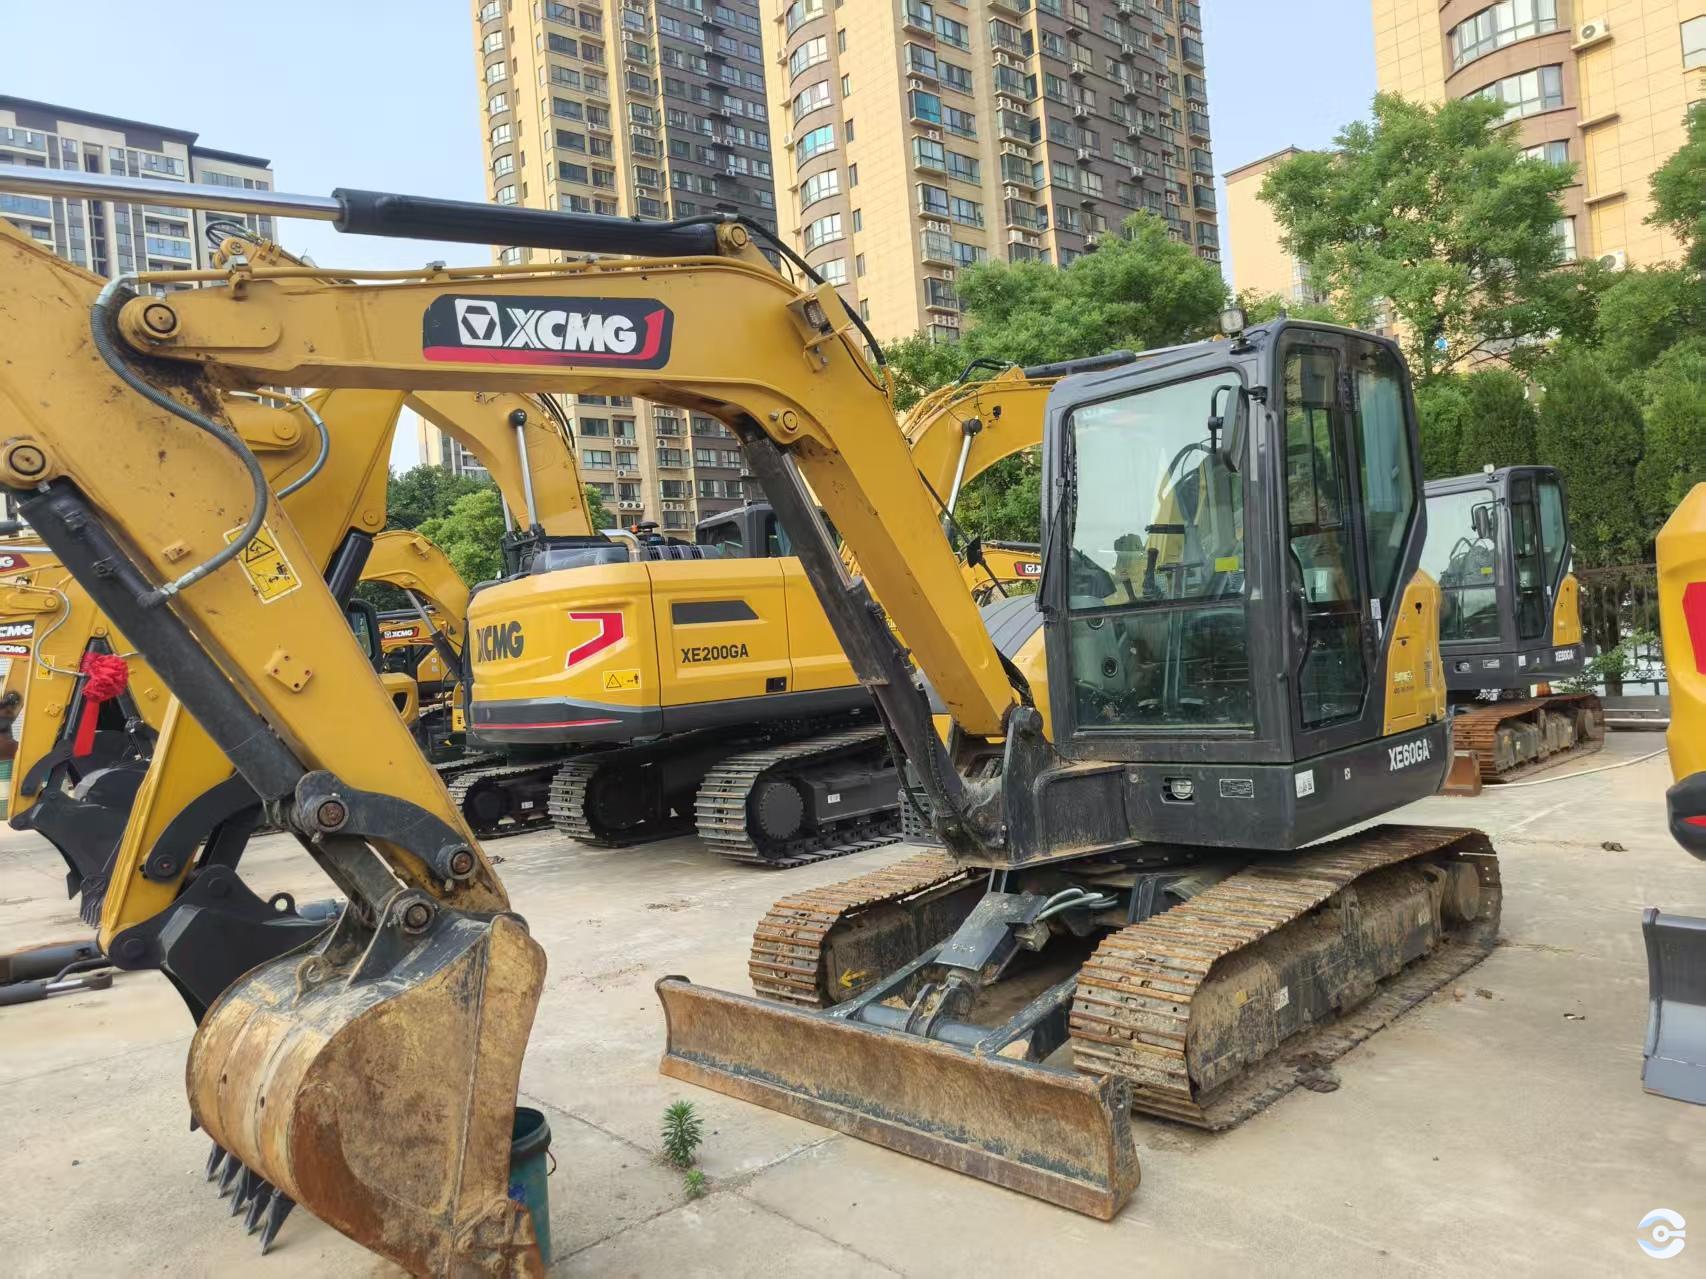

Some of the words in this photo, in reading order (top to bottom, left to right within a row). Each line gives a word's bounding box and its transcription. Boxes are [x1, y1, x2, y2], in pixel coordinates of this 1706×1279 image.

[502, 307, 637, 354] XCMG
[0, 624, 33, 637] CMG
[392, 630, 413, 638] XCMG
[476, 620, 524, 663] XCMG
[681, 643, 749, 663] XE200GA
[1388, 738, 1430, 771] XE60GA
